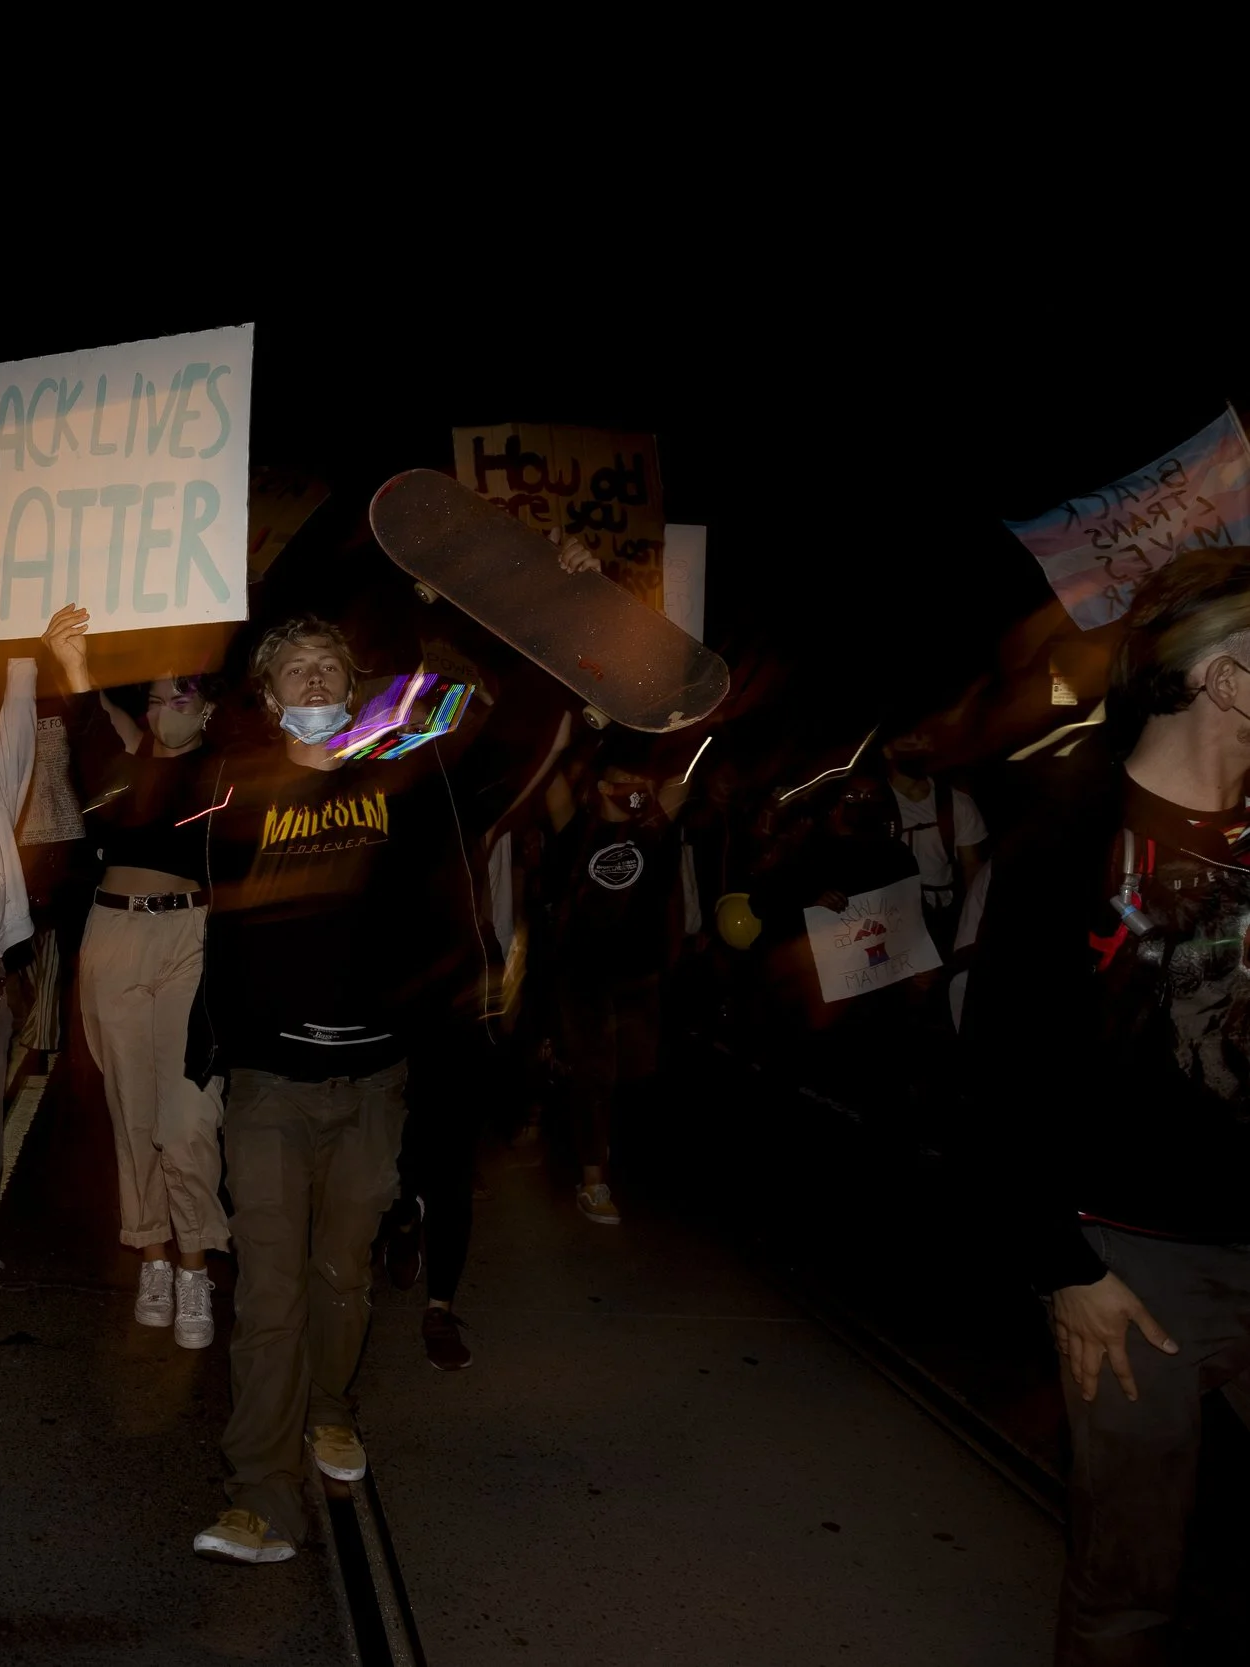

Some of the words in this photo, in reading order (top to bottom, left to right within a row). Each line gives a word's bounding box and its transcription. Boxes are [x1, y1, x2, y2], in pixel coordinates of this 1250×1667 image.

[90, 362, 232, 460] LIVES
[472, 434, 581, 497] How
[261, 787, 389, 850] MALCOLM
[285, 836, 368, 854] FOREVER
